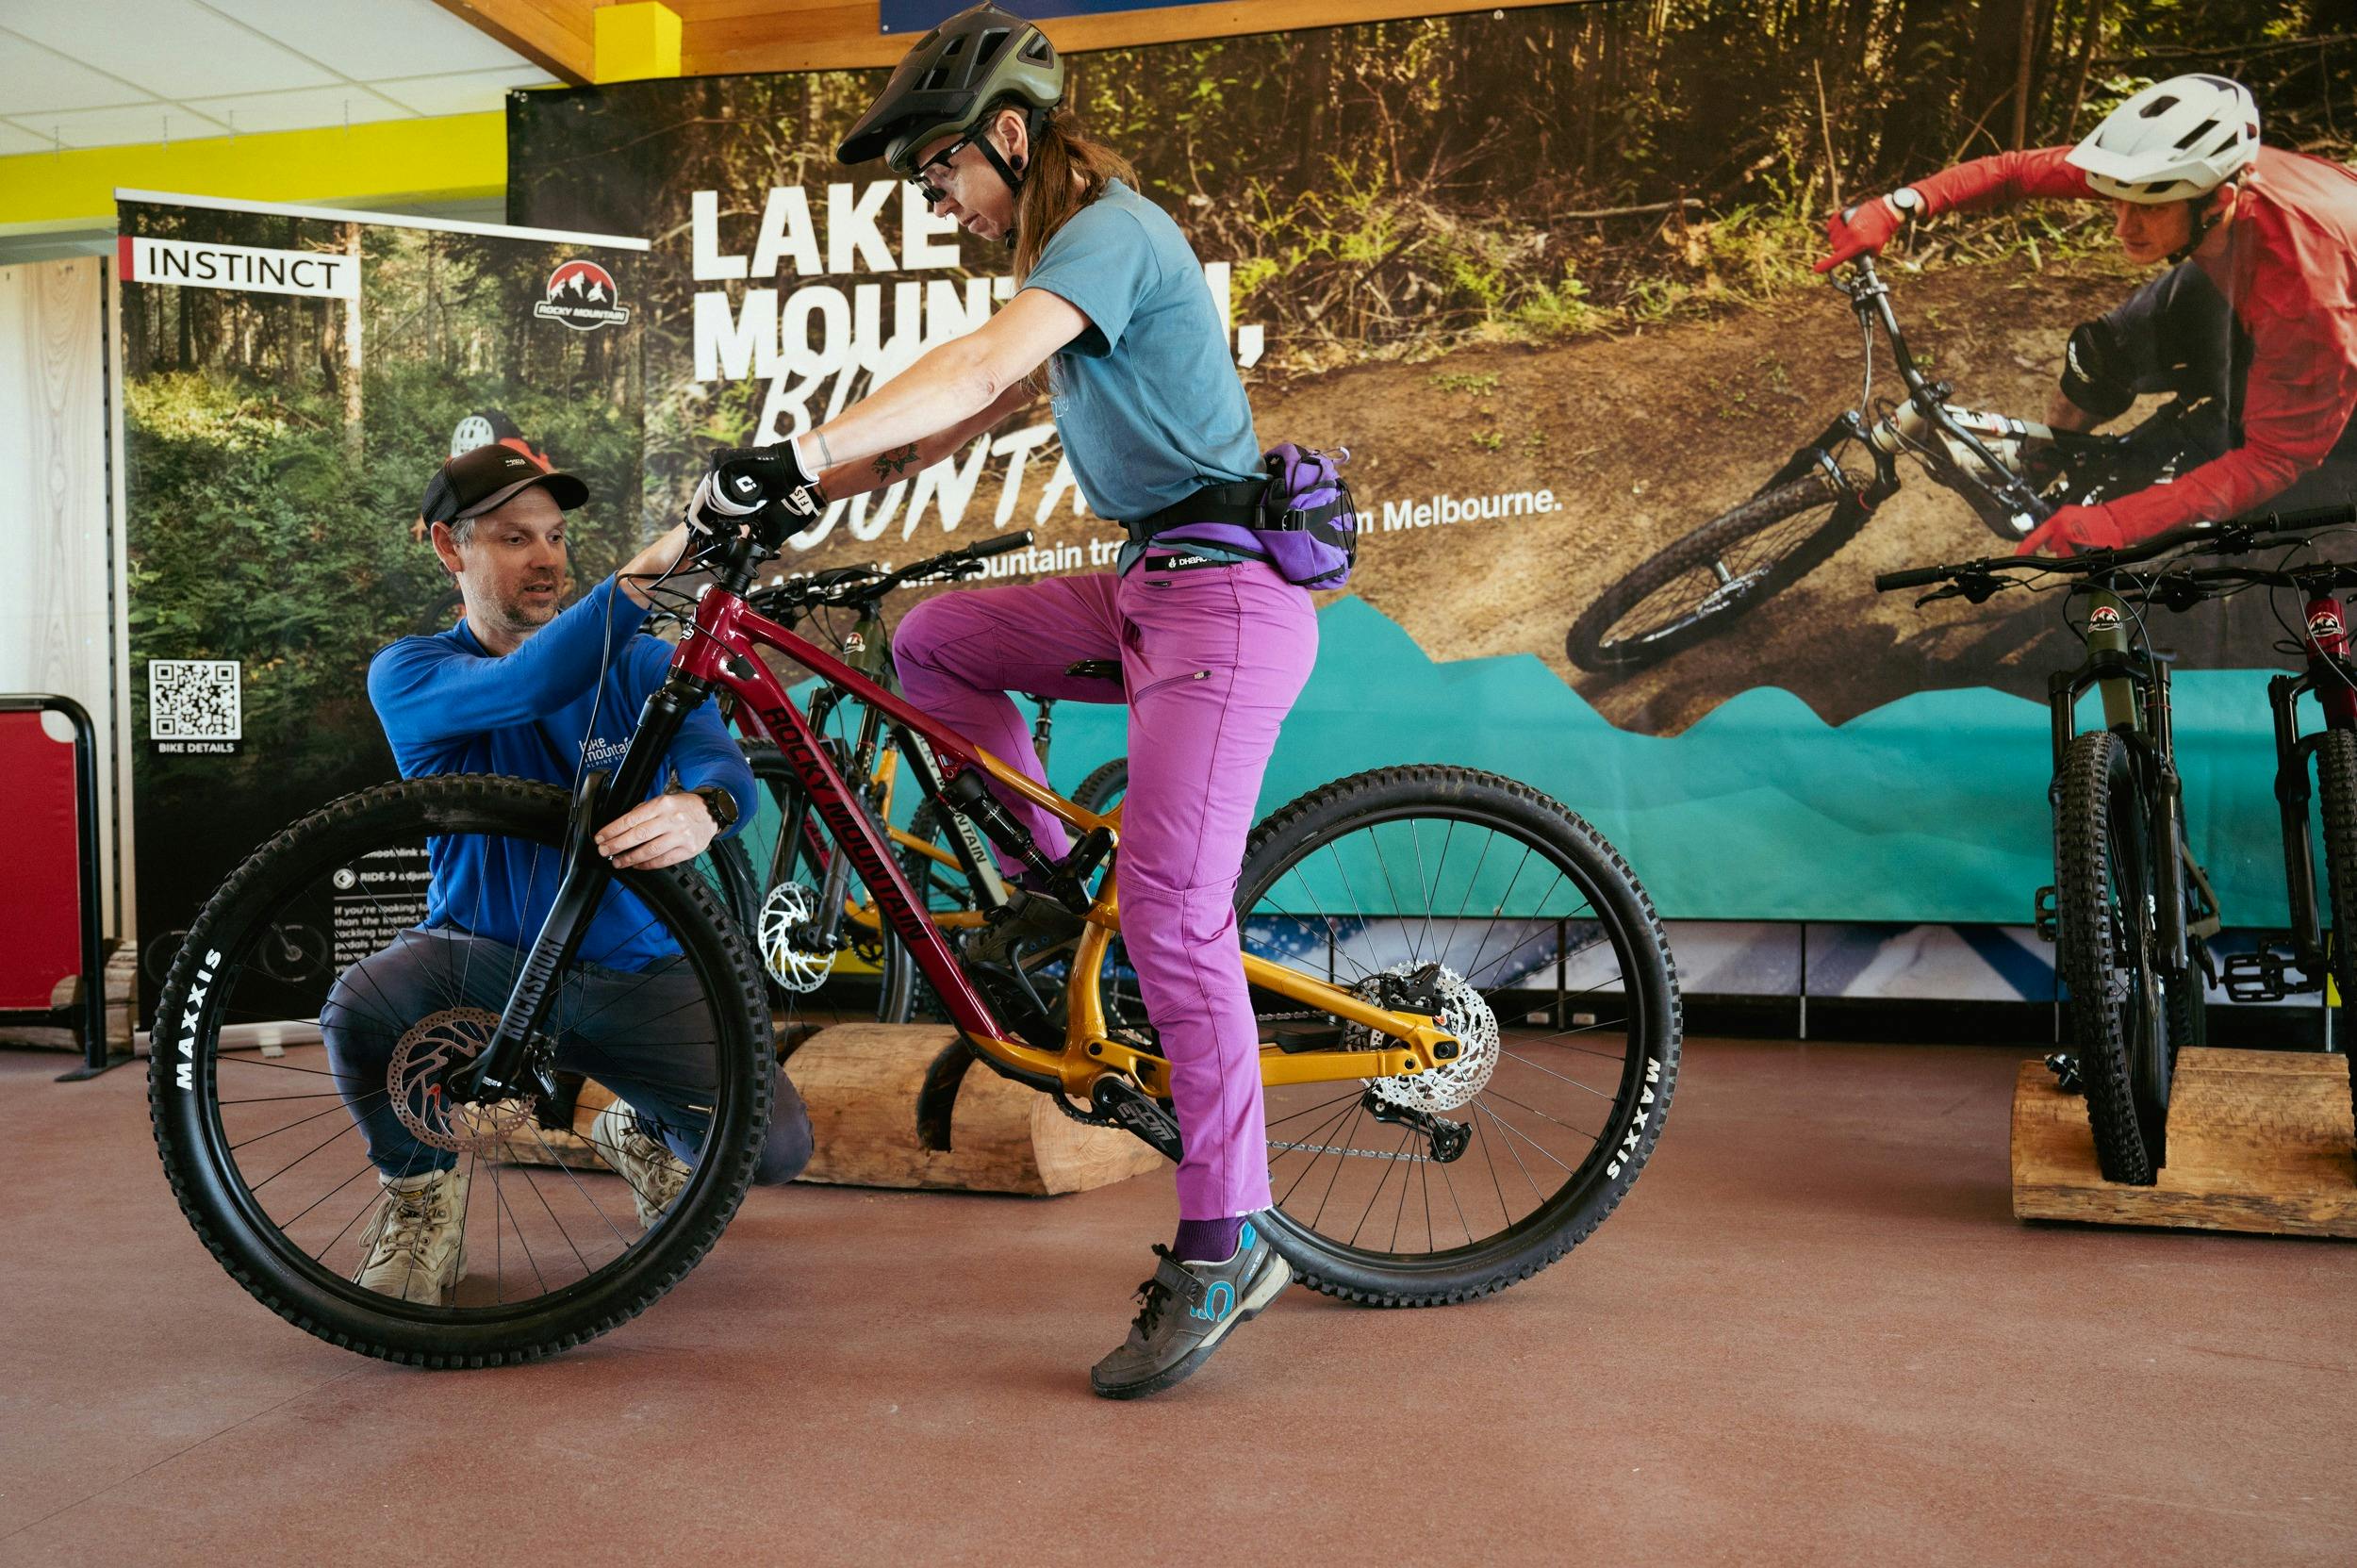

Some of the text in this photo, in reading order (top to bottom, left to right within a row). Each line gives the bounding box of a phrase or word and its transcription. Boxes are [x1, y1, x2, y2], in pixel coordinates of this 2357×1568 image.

[692, 180, 961, 281] LAKE
[149, 247, 340, 289] INSTINCT
[537, 305, 625, 321] ROCKY MOUNTAIN
[793, 488, 810, 507] FIS
[1382, 487, 1563, 532] Melbourne.
[957, 536, 1127, 582] ountain tra
[158, 742, 235, 753] BIKE DETAILS
[762, 707, 930, 941] ROCKY MOUNTAIN
[360, 871, 397, 883] RIDE-9
[334, 905, 342, 916] If
[343, 905, 376, 916] you're
[334, 917, 360, 927] than
[362, 916, 379, 926] the
[175, 947, 223, 1092] MAXXIS
[1606, 1056, 1661, 1180] MAXXIS
